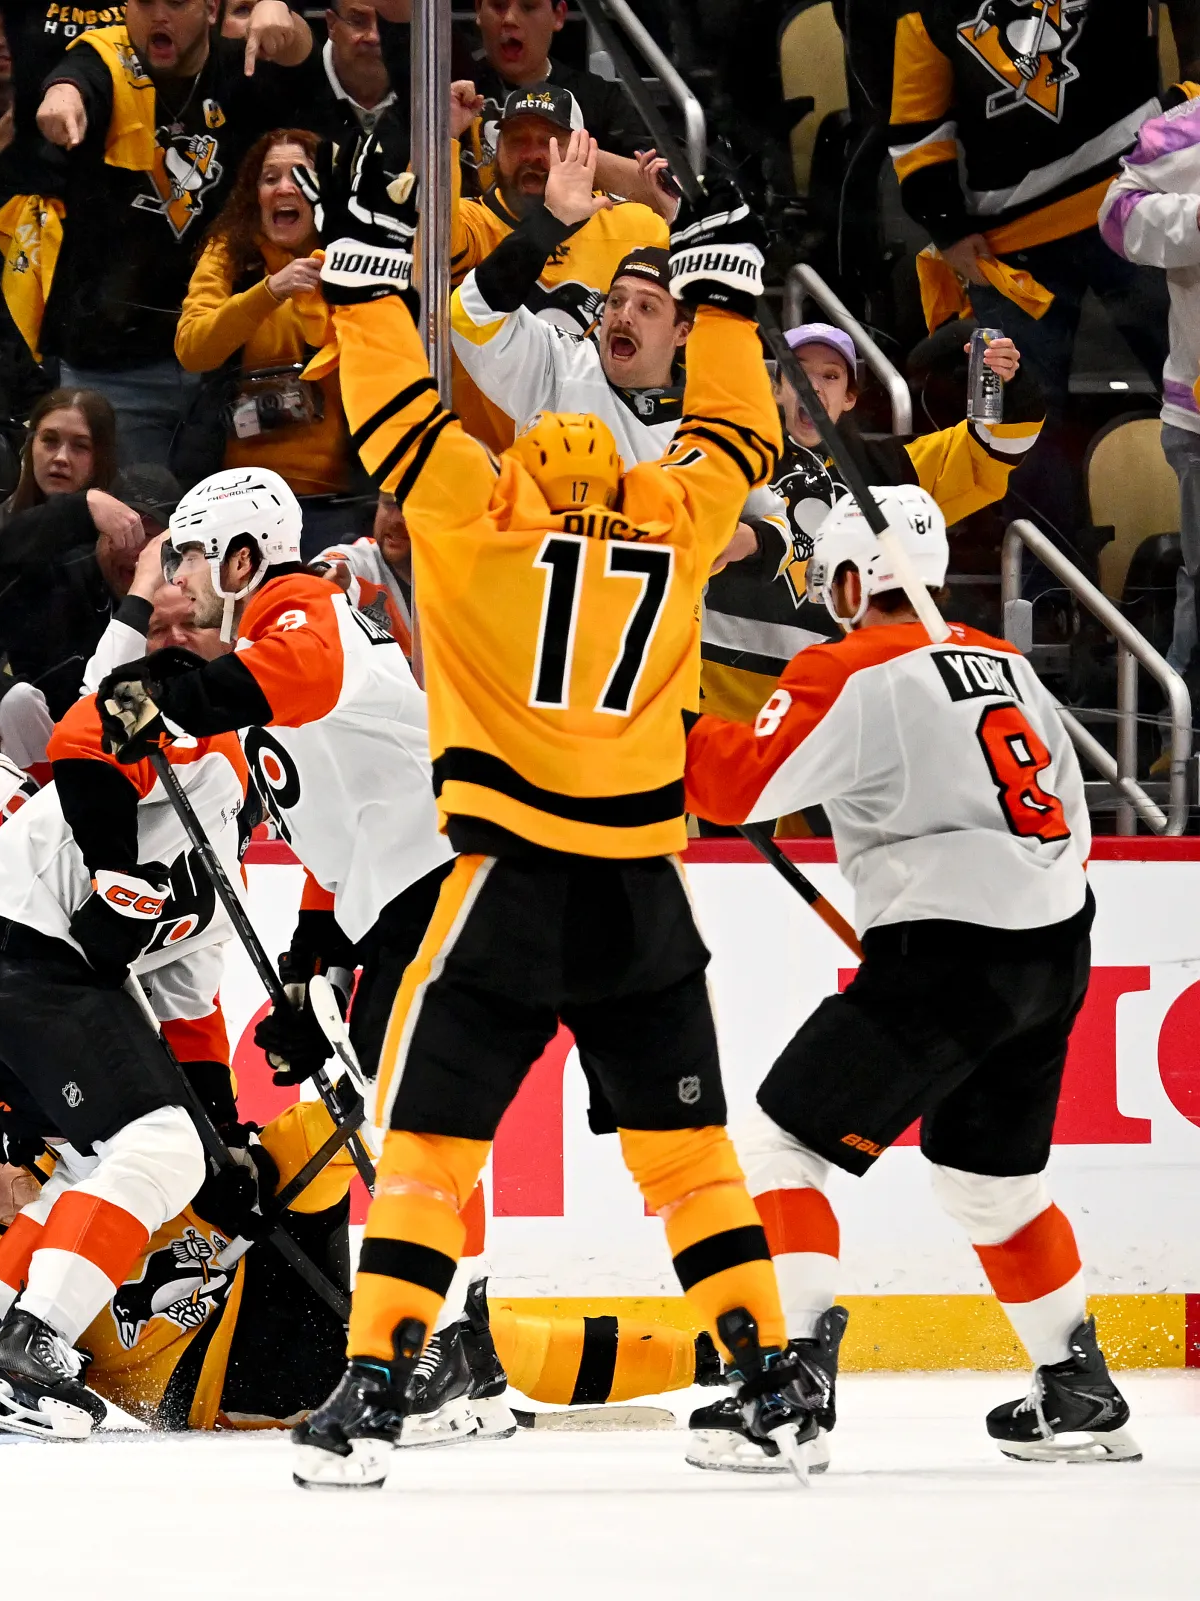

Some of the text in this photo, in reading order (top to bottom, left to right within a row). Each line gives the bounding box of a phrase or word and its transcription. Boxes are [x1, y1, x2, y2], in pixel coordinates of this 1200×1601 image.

[46, 2, 127, 24] PENGUI
[515, 100, 556, 111] NECTAR
[330, 251, 412, 281] ARRIOR
[669, 252, 757, 281] WARRIO
[571, 481, 589, 503] 17
[528, 531, 674, 717] 17
[943, 653, 1019, 700] YORK
[754, 688, 793, 737] 8
[975, 701, 1071, 844] 8
[841, 1133, 888, 1157] BAU
